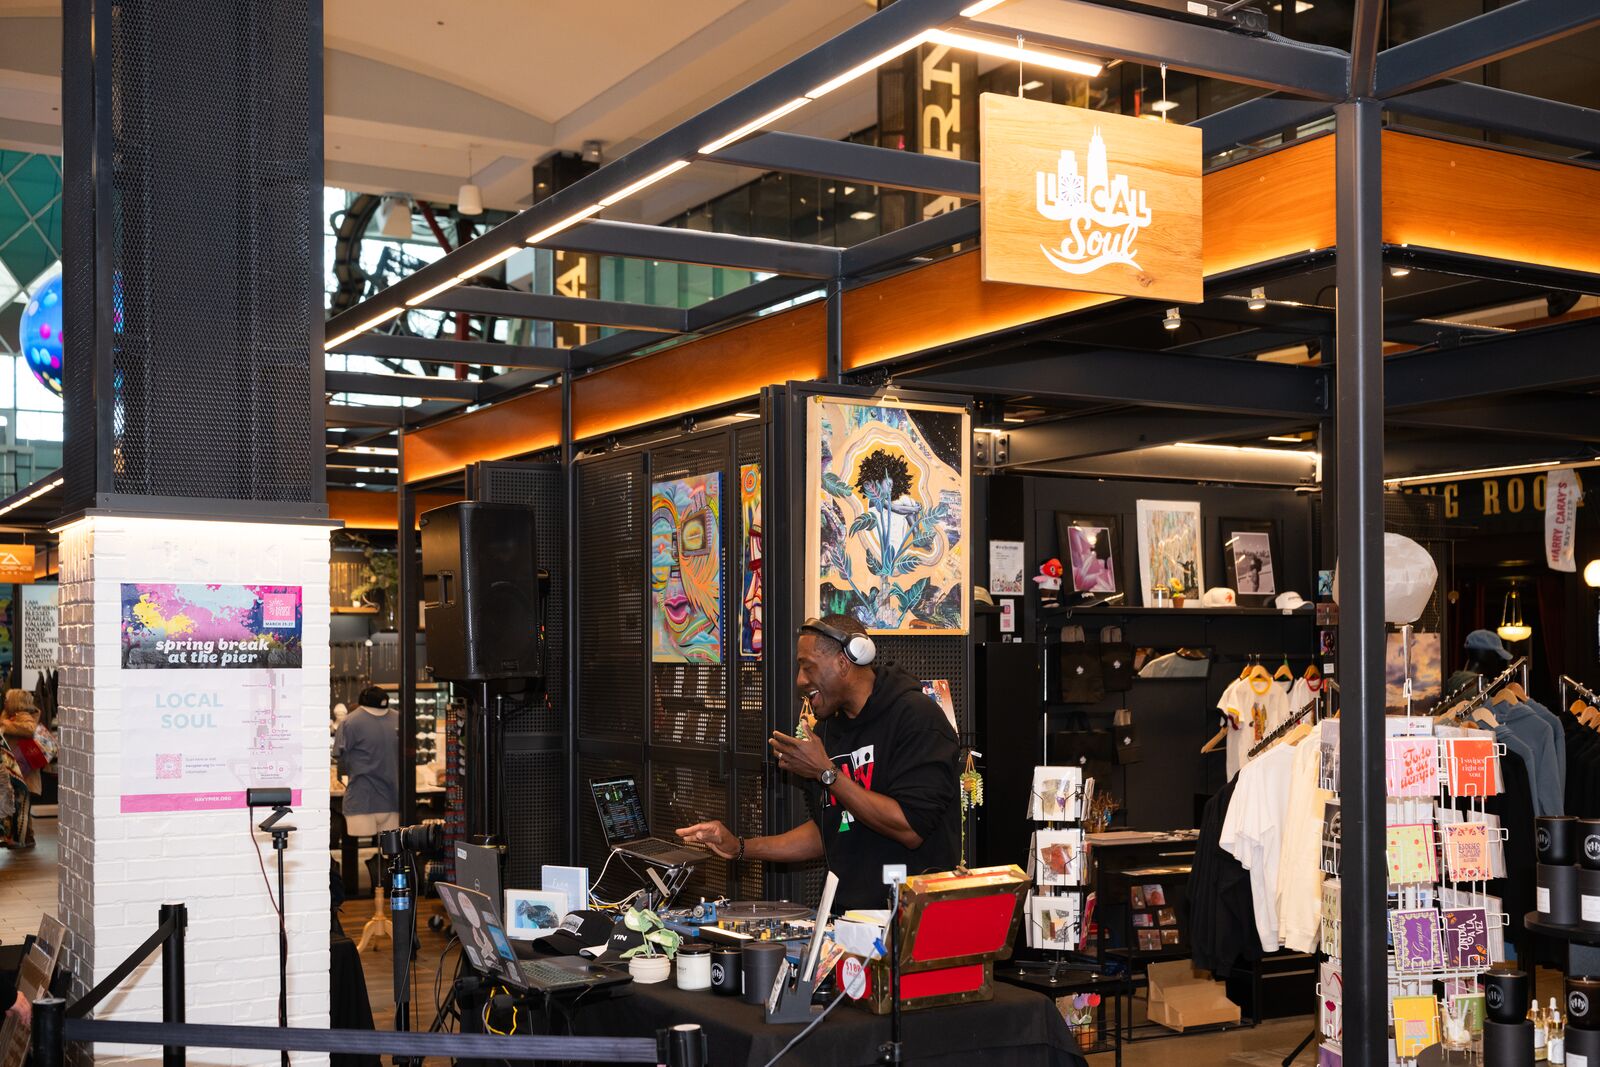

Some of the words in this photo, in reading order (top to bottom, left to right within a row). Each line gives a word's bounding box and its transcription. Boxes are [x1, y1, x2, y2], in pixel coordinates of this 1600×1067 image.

[1036, 170, 1152, 227] LOCAL
[1058, 216, 1139, 260] Soul
[1482, 472, 1585, 515] ROO
[1551, 528, 1564, 562] HARRY
[155, 637, 214, 654] spring
[218, 637, 270, 651] break
[168, 652, 187, 663] at
[190, 651, 218, 663] the
[221, 650, 258, 667] pier
[155, 692, 224, 708] LOCAL
[161, 713, 217, 729] SOUL
[1474, 920, 1484, 935] VEZ
[613, 934, 628, 942] YIN
